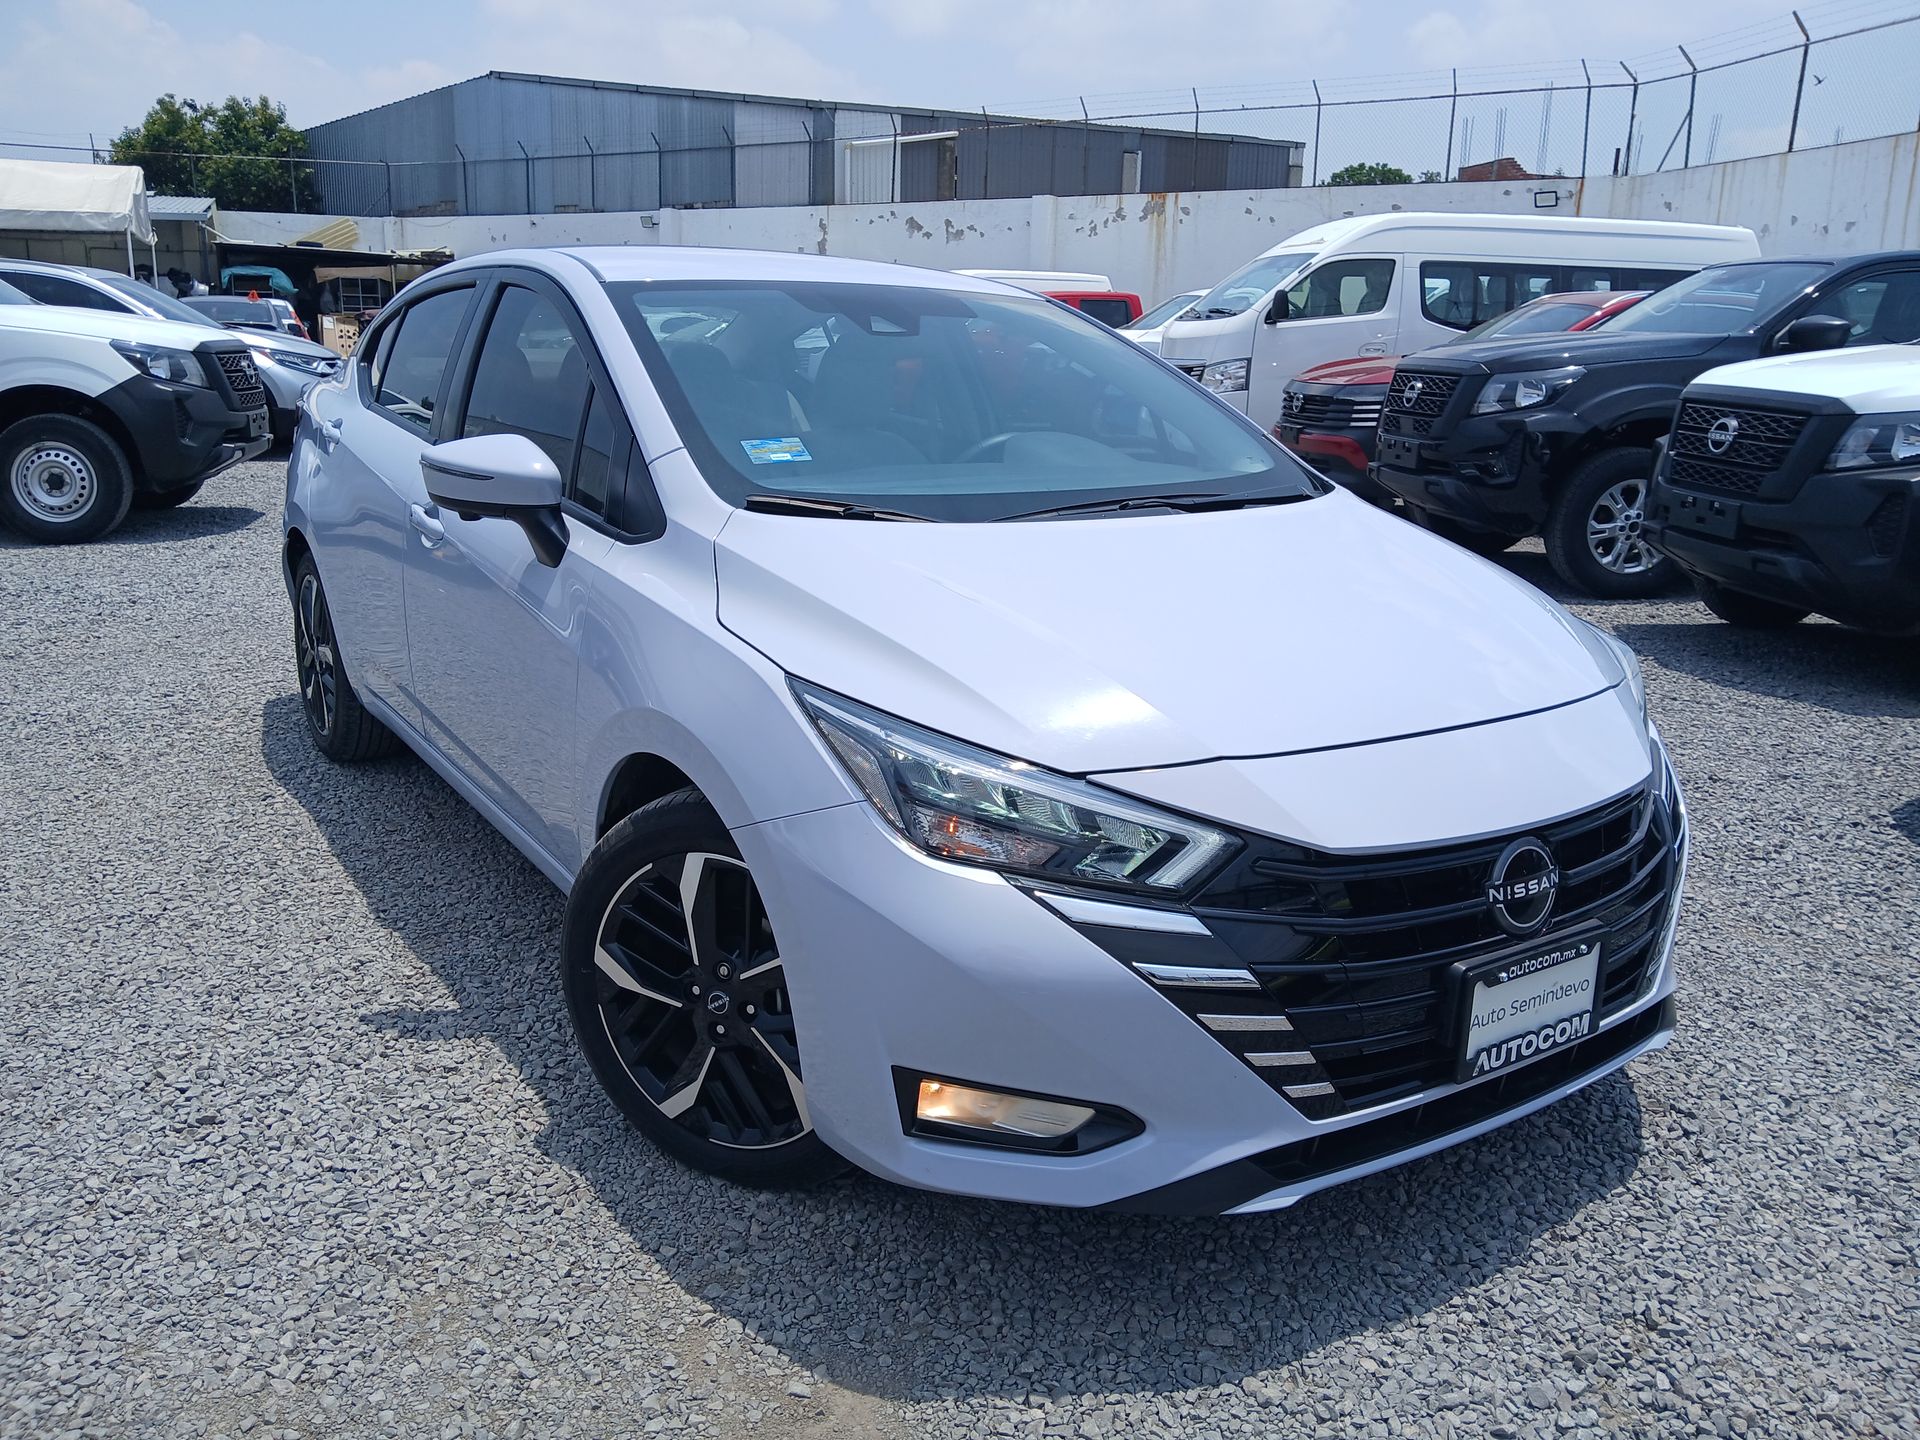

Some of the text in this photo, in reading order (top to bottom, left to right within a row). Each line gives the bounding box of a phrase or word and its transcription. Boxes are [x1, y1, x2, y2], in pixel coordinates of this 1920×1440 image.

[1489, 870, 1559, 902] NISSAN
[1509, 948, 1577, 978] autocom.mx
[1470, 979, 1590, 1031] Auto Seminuevo
[1472, 1012, 1591, 1077] AUTOCOM
